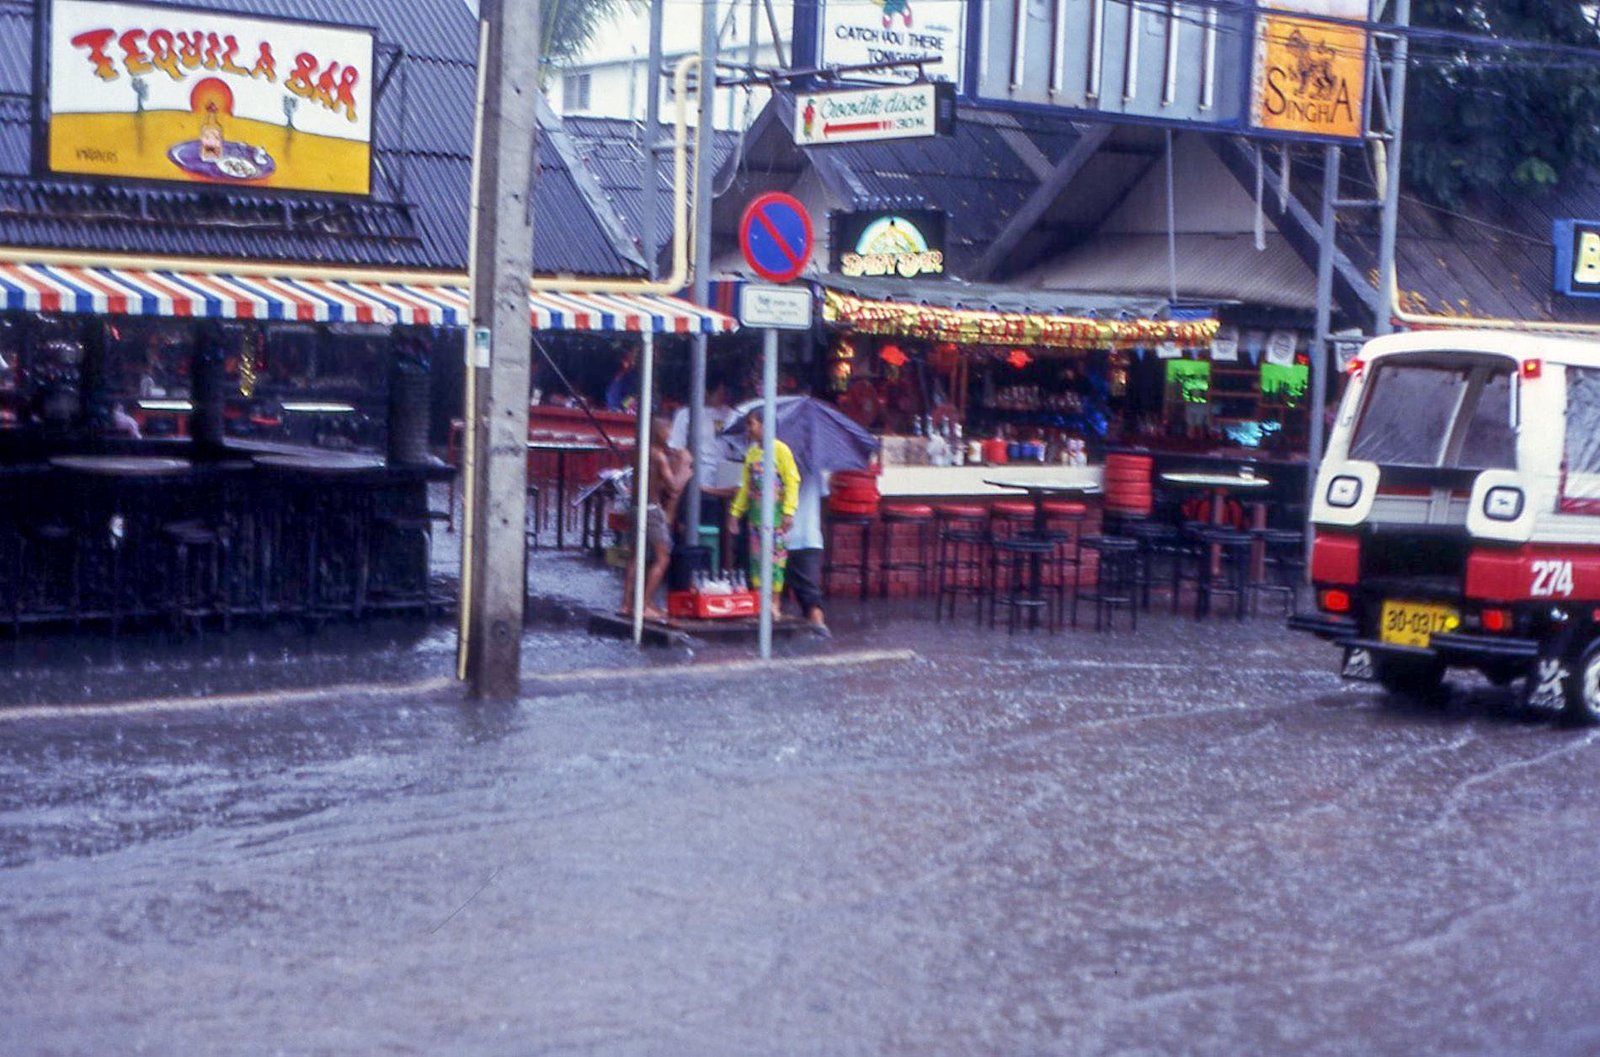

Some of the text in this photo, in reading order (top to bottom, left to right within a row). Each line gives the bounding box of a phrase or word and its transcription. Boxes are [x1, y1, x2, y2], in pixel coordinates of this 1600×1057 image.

[836, 25, 945, 51] CATCH YOU THERE
[71, 28, 359, 123] TEQUILA BAR
[884, 92, 926, 113] disco
[1264, 66, 1353, 123] SINGHA
[1531, 560, 1575, 597] 274
